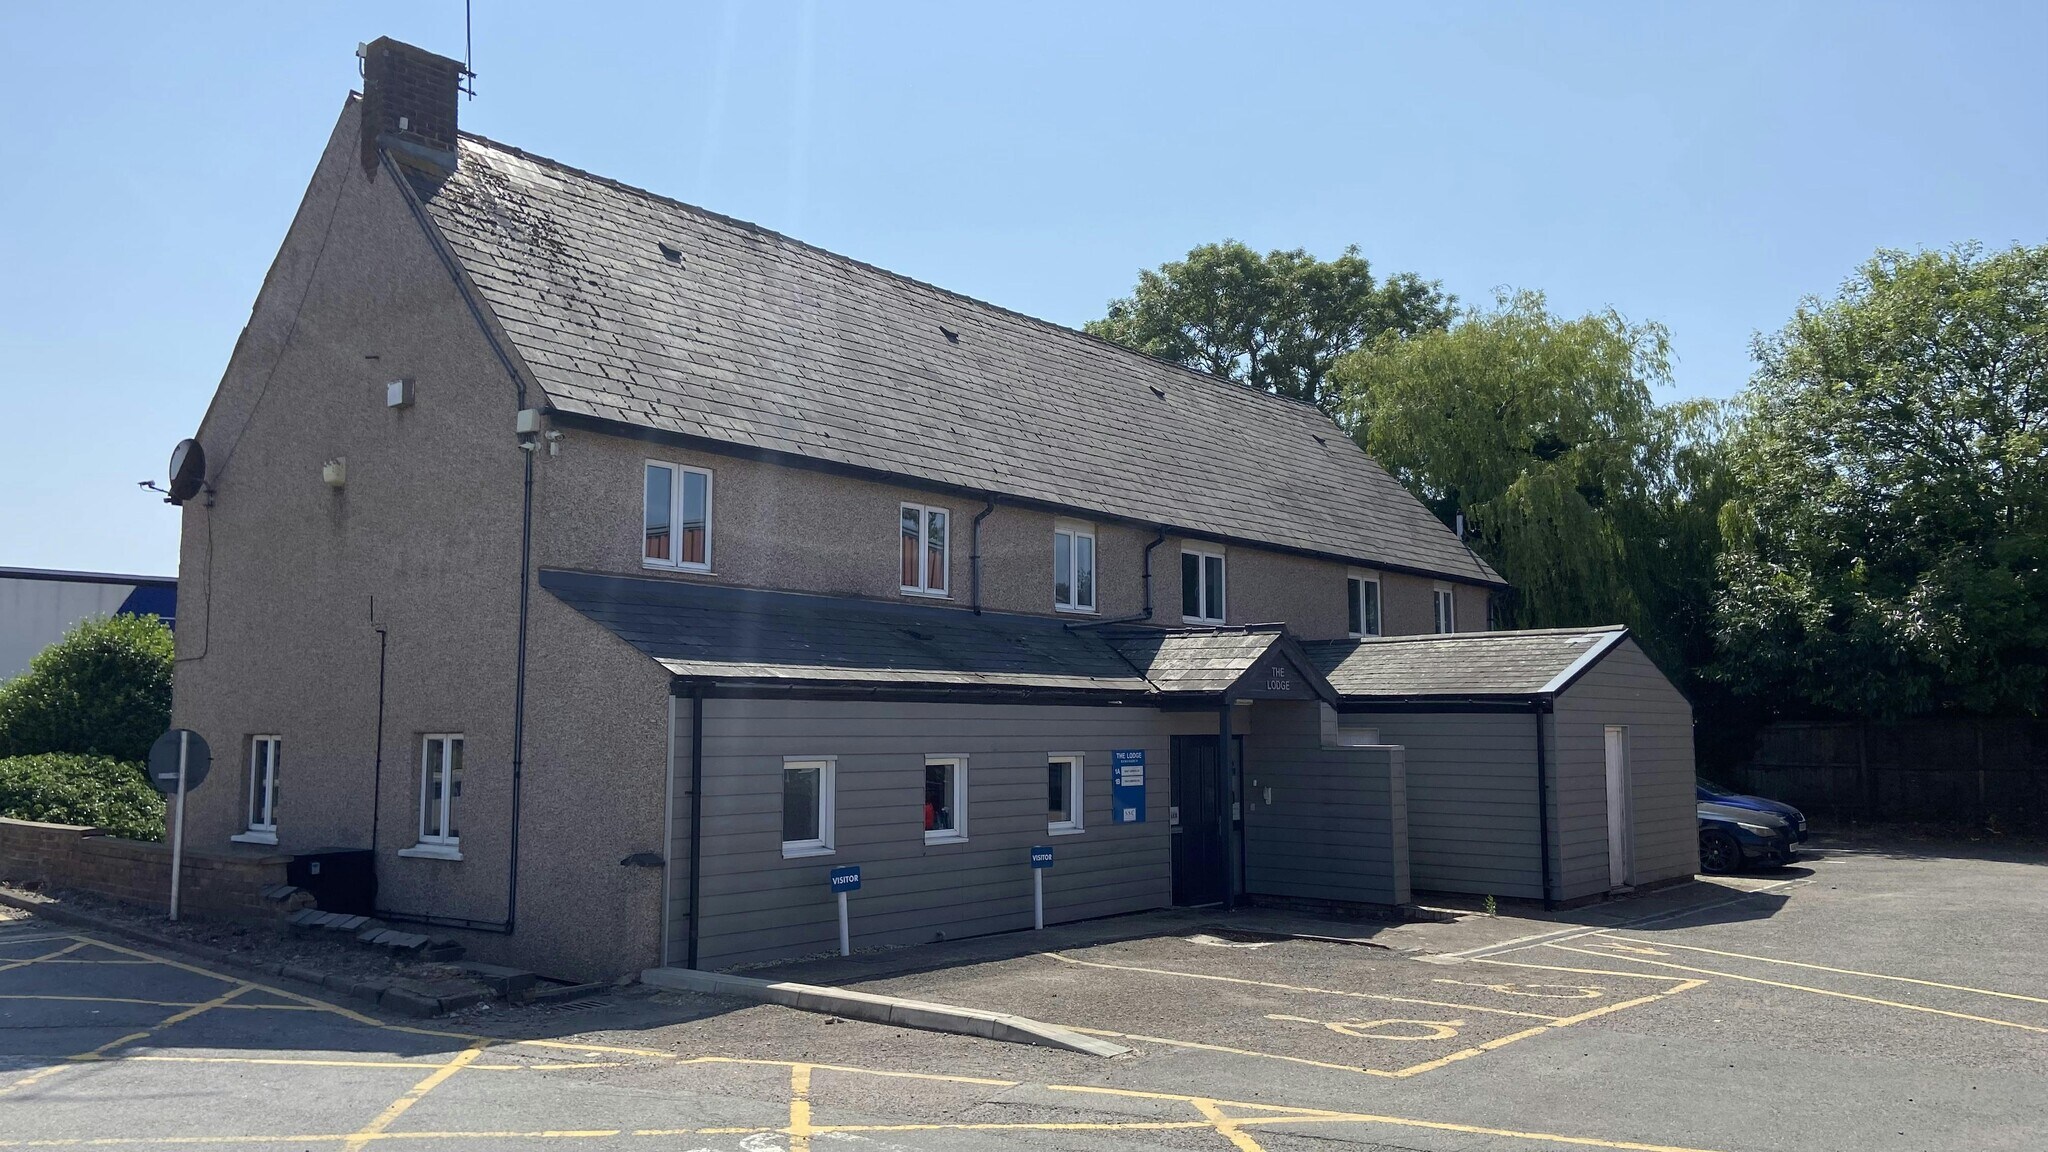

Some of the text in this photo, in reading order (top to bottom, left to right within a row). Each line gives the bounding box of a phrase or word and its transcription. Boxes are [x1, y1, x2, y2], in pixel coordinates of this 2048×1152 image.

[1271, 666, 1285, 677] THE
[1266, 680, 1290, 690] LODGE
[1032, 854, 1053, 862] VISITOR
[832, 874, 859, 885] VISITOR
